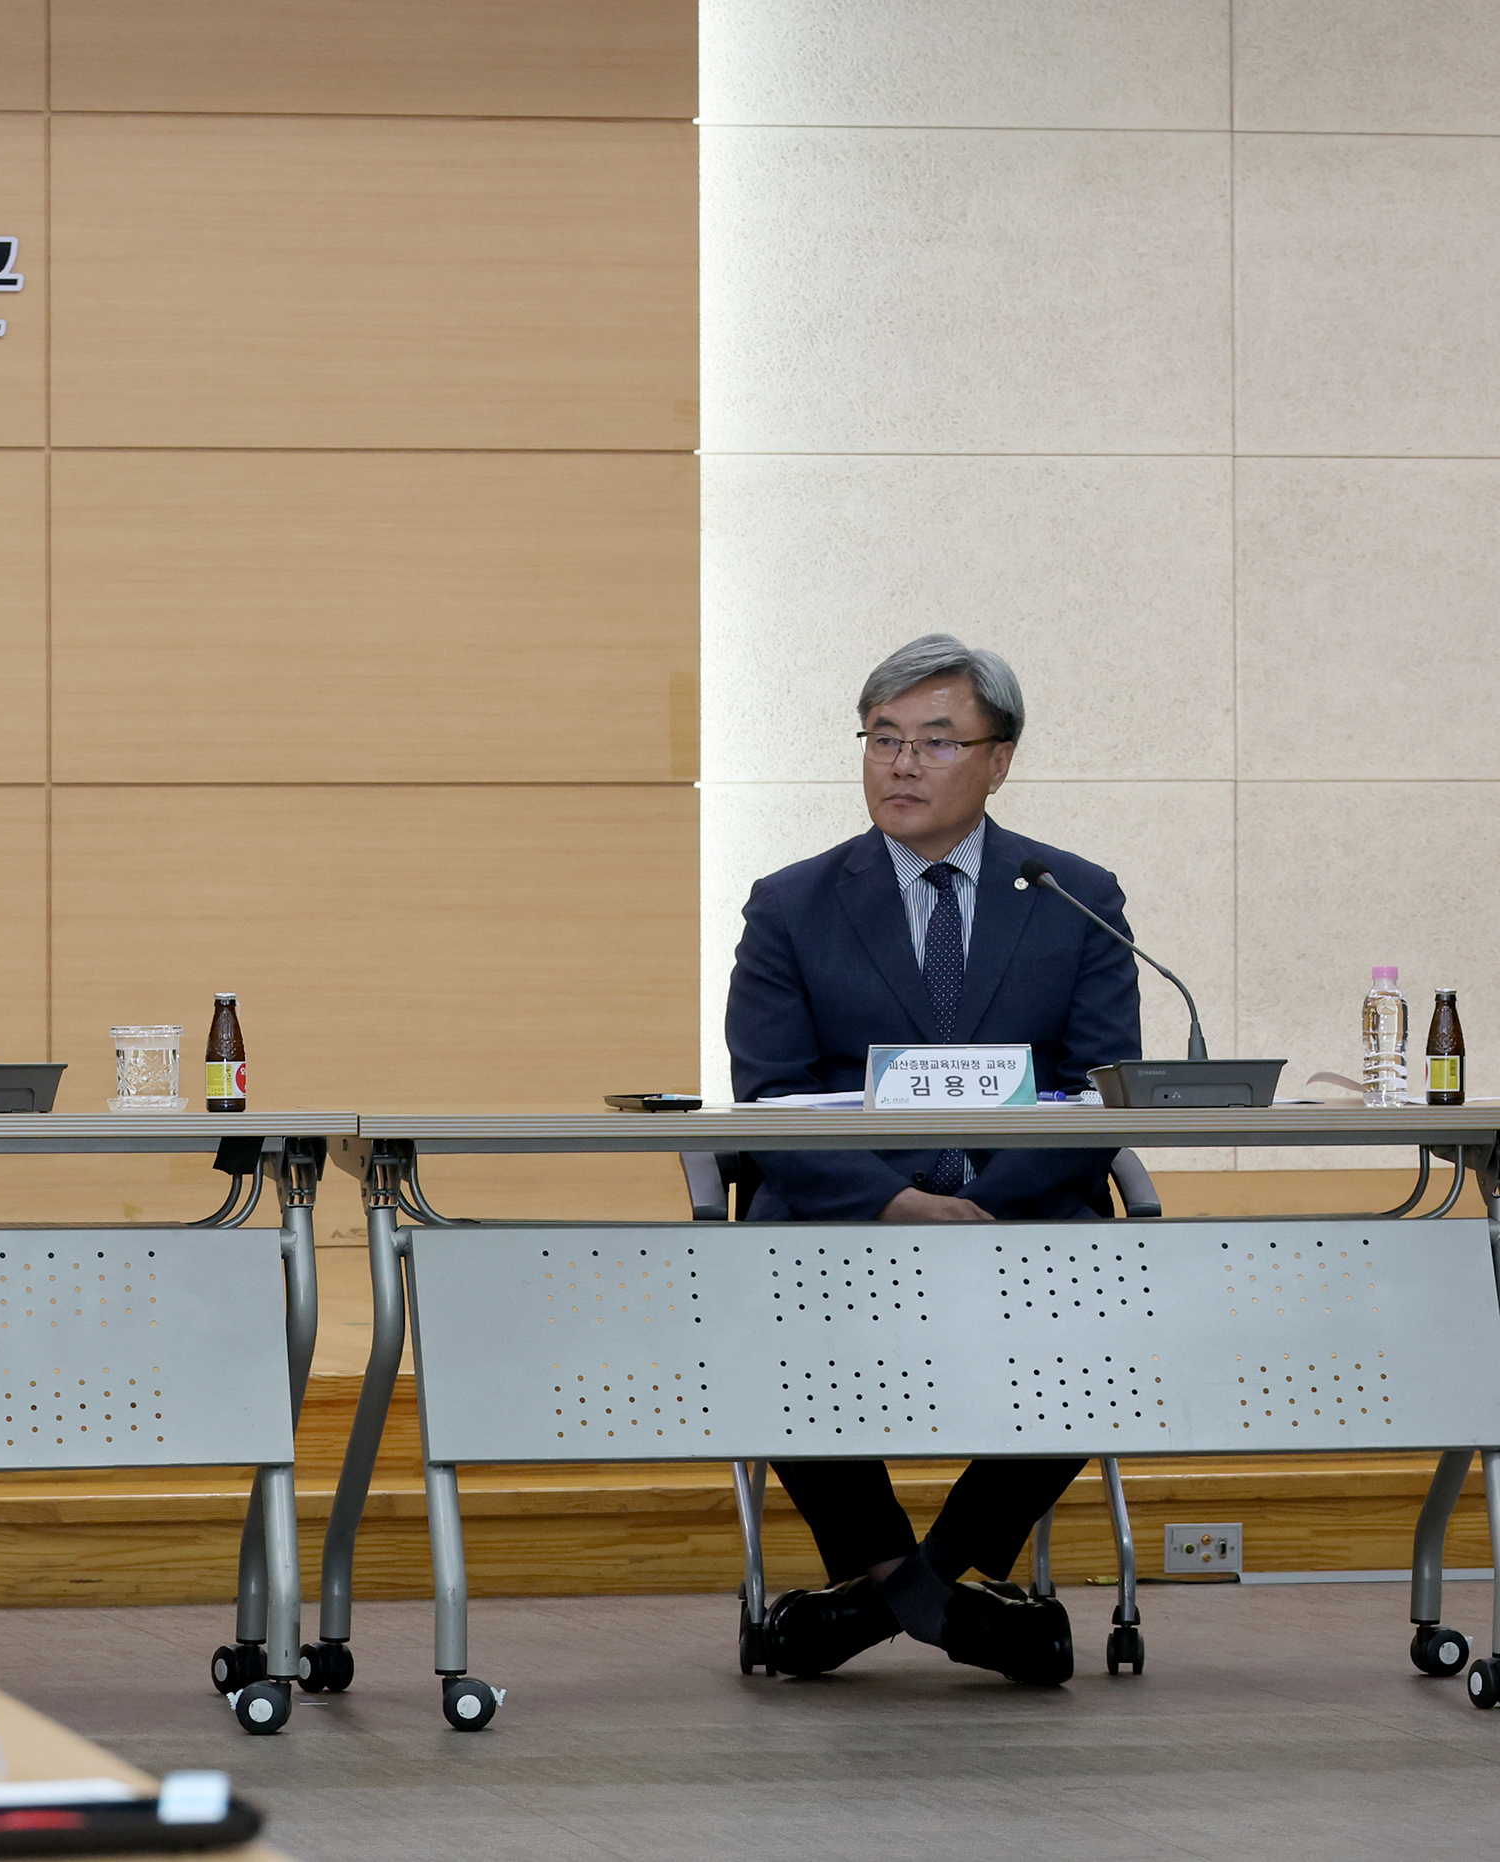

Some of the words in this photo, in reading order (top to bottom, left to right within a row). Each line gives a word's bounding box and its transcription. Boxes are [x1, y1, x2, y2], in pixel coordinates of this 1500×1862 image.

[888, 1059, 980, 1070] 괴산증평교육지원청
[986, 1059, 1016, 1070] 교육장
[910, 1075, 1000, 1097] 김용인
